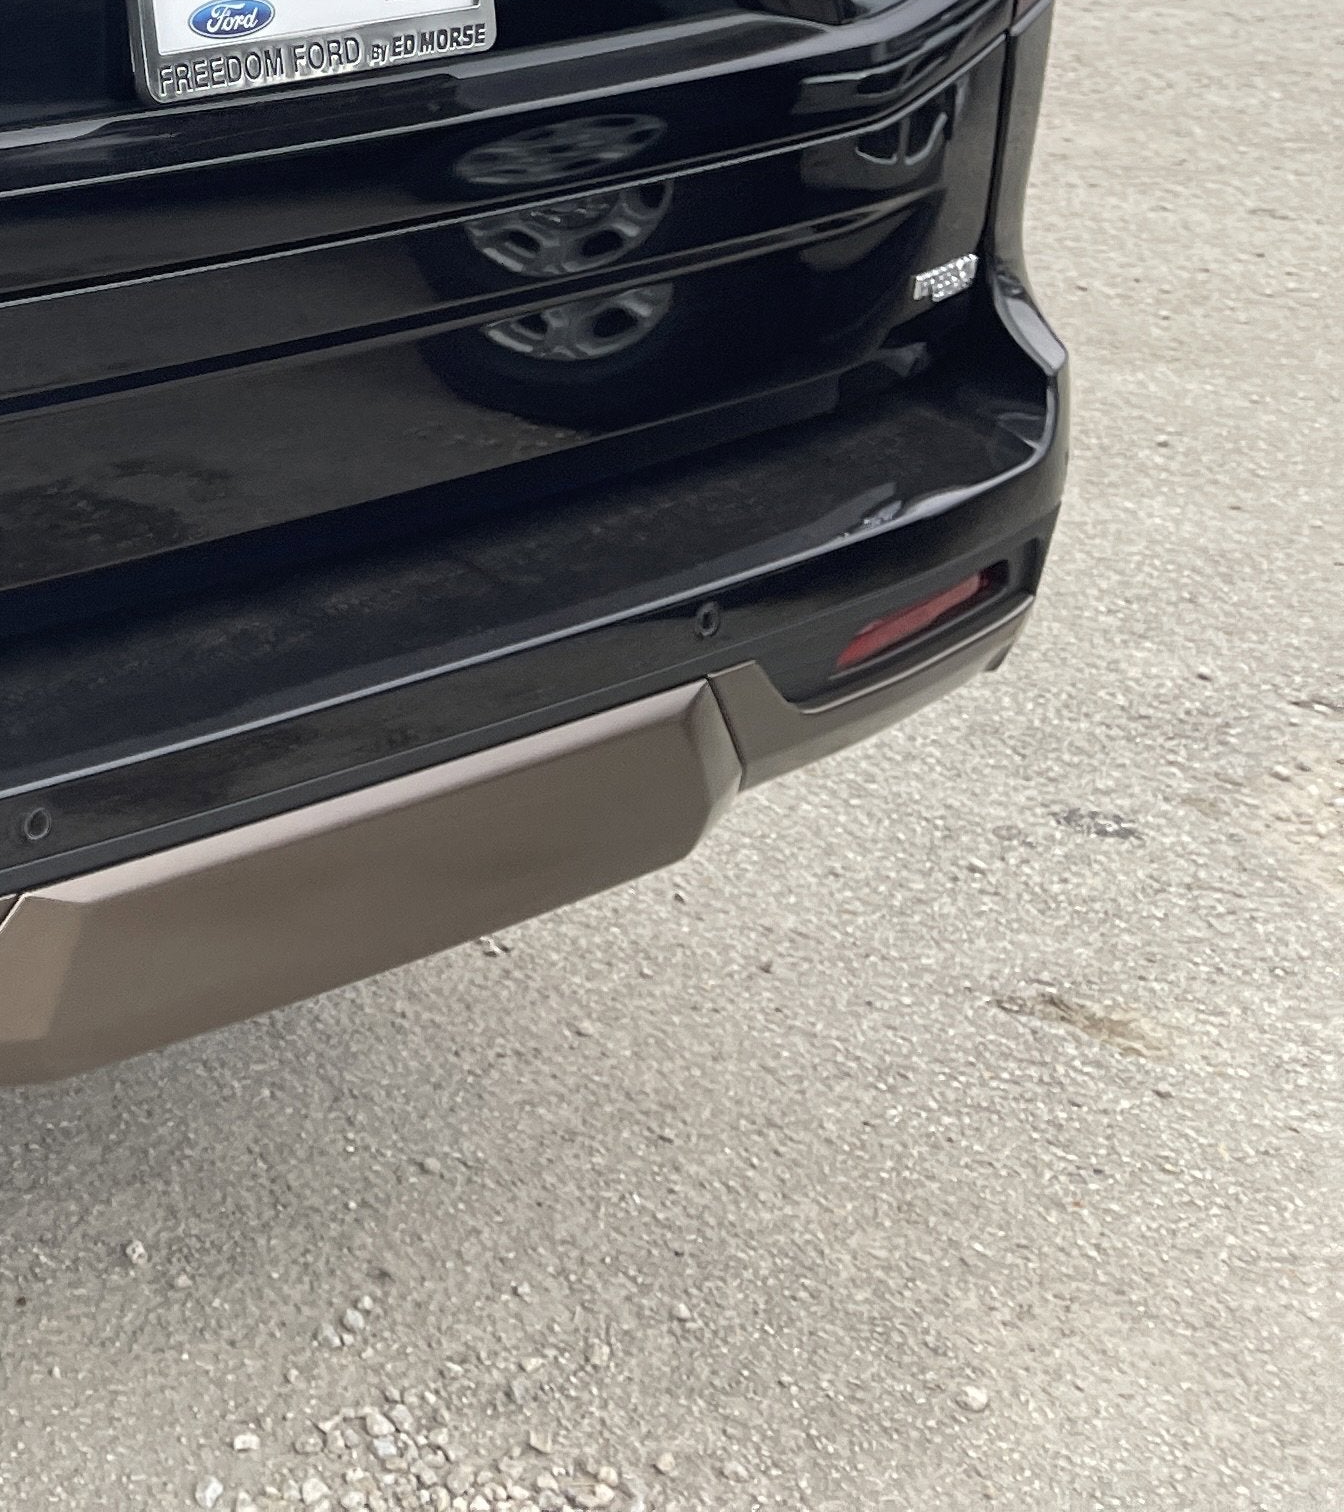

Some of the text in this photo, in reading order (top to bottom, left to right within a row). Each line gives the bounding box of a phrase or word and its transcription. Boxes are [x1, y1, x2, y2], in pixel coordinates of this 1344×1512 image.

[206, 2, 259, 32] Ford
[158, 47, 284, 97] FREEDOM
[293, 37, 360, 71] FORD
[390, 34, 415, 58] ED
[418, 23, 487, 54] MORSE
